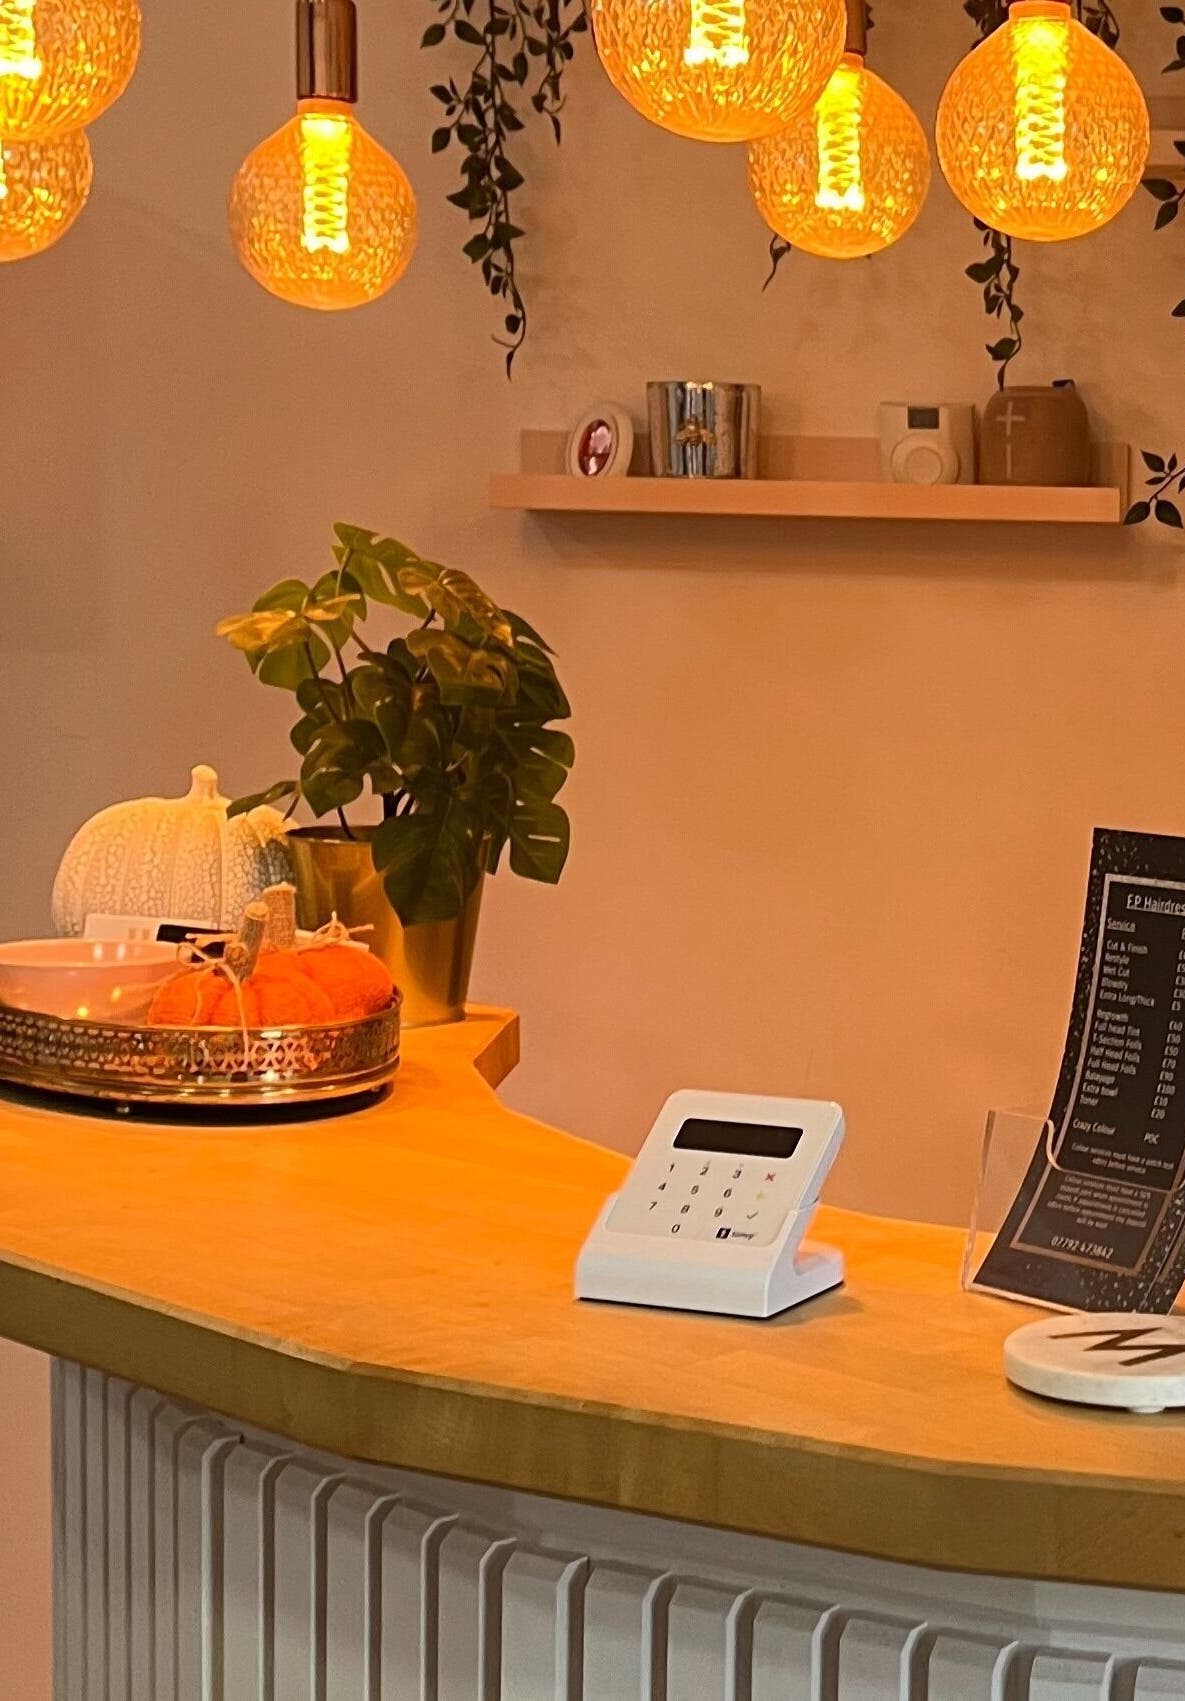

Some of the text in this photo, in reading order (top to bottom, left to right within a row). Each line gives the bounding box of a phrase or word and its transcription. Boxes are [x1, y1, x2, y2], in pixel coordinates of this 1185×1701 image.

[1107, 917, 1135, 932] Service
[1073, 1118, 1092, 1132] Crazy
[700, 1167, 708, 1176] 2
[733, 1169, 741, 1179] 3
[658, 1182, 666, 1190] 4
[649, 1201, 657, 1210] 7
[672, 1224, 680, 1233] 0
